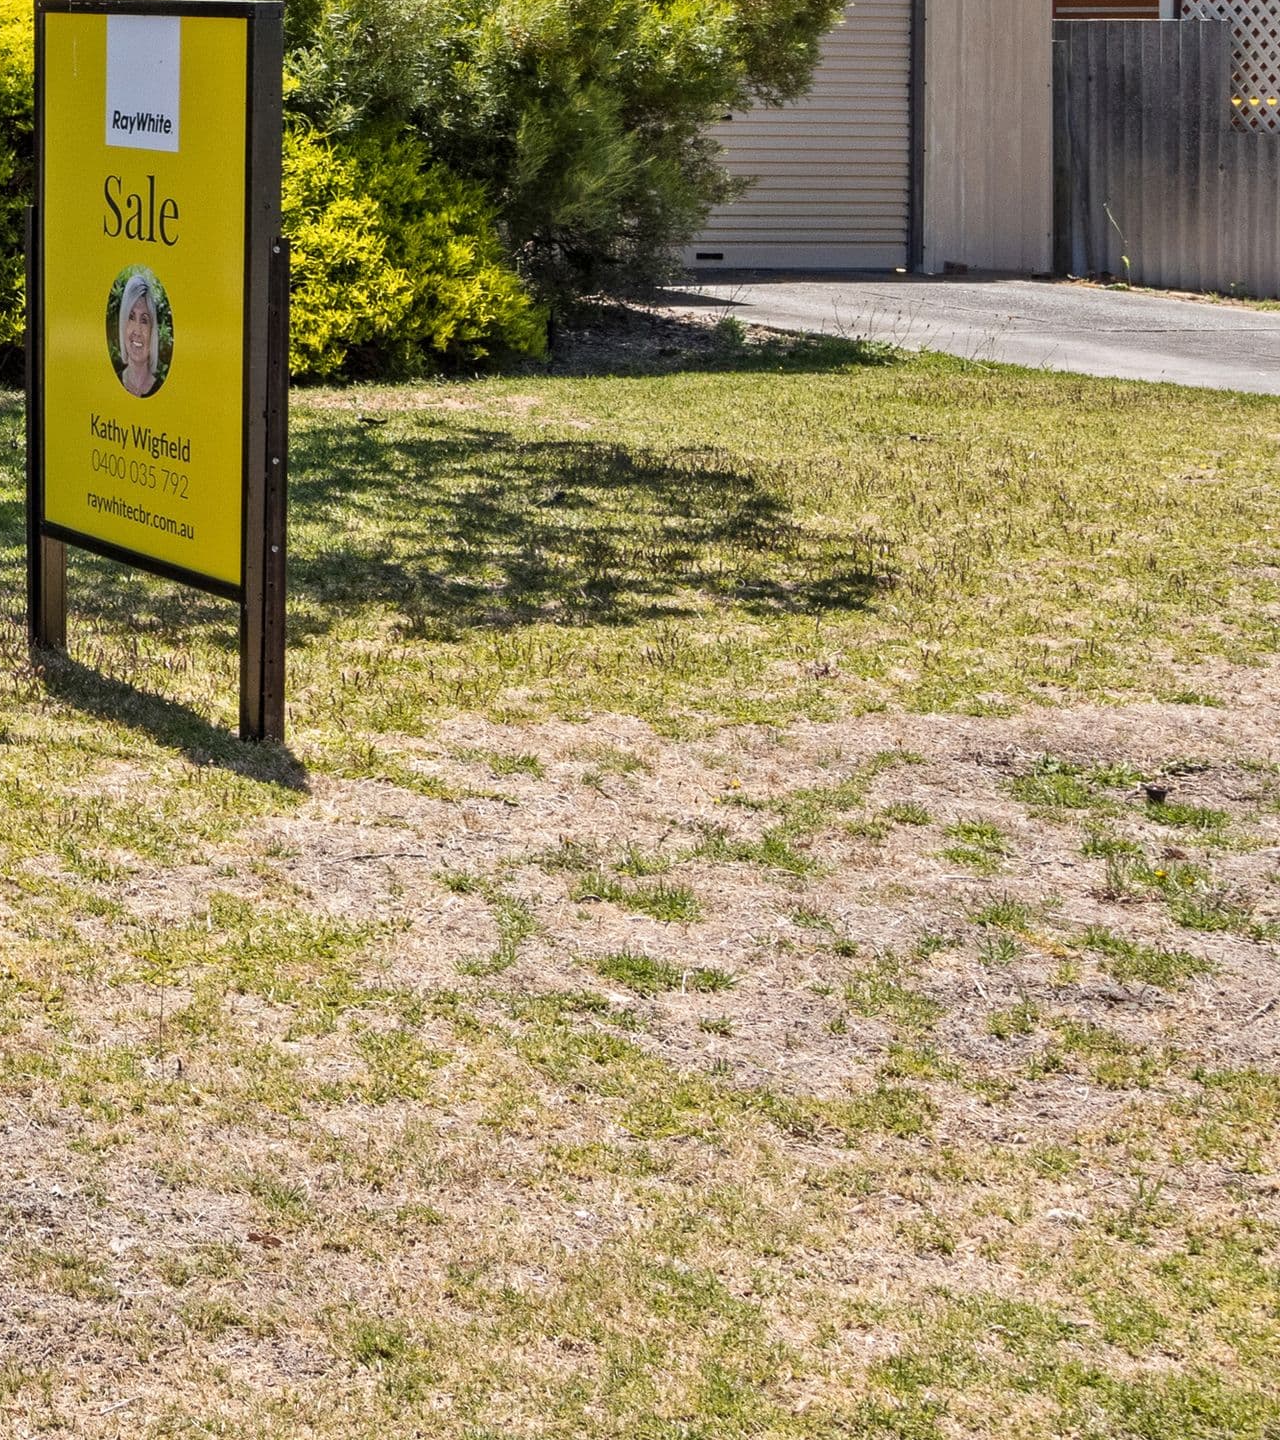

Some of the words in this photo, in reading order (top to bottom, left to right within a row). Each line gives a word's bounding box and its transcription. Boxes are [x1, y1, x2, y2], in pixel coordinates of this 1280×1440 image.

[103, 175, 179, 247] Sale
[91, 413, 129, 450] Kathy
[131, 424, 191, 464] Wigfield
[91, 448, 126, 480] 0400
[130, 460, 157, 489] 035
[161, 468, 189, 500] 792
[87, 492, 195, 540] raywhitecbr.com.au
